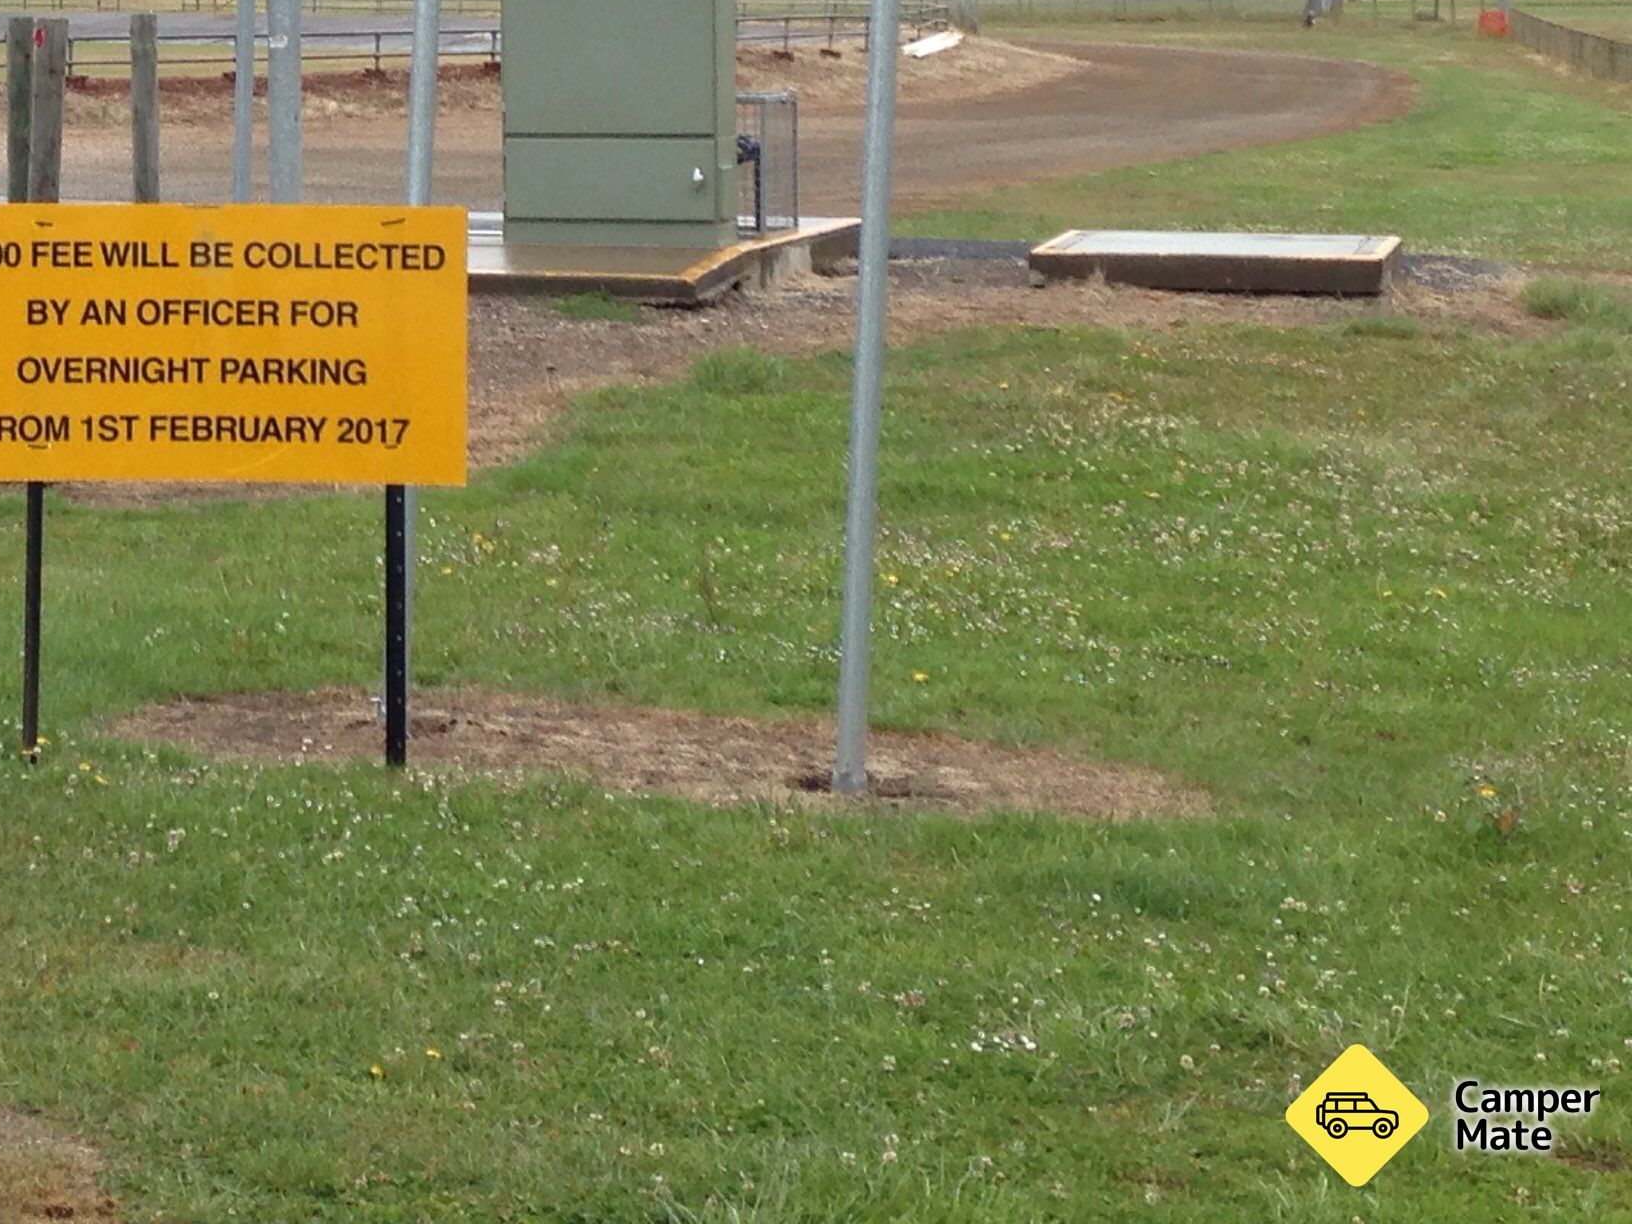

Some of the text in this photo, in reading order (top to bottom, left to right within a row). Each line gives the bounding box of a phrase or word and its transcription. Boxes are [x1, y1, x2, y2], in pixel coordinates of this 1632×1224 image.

[31, 241, 93, 268] FEE
[101, 242, 180, 269] WILL
[189, 242, 234, 269] BE
[243, 242, 446, 271] COLLECTED
[27, 299, 359, 327] BY AN OFFICER FOR
[17, 357, 367, 386] OVERNIGHT PARKING
[80, 416, 140, 442] 1ST
[149, 417, 327, 443] FEBRUARY
[336, 418, 411, 444] 2017
